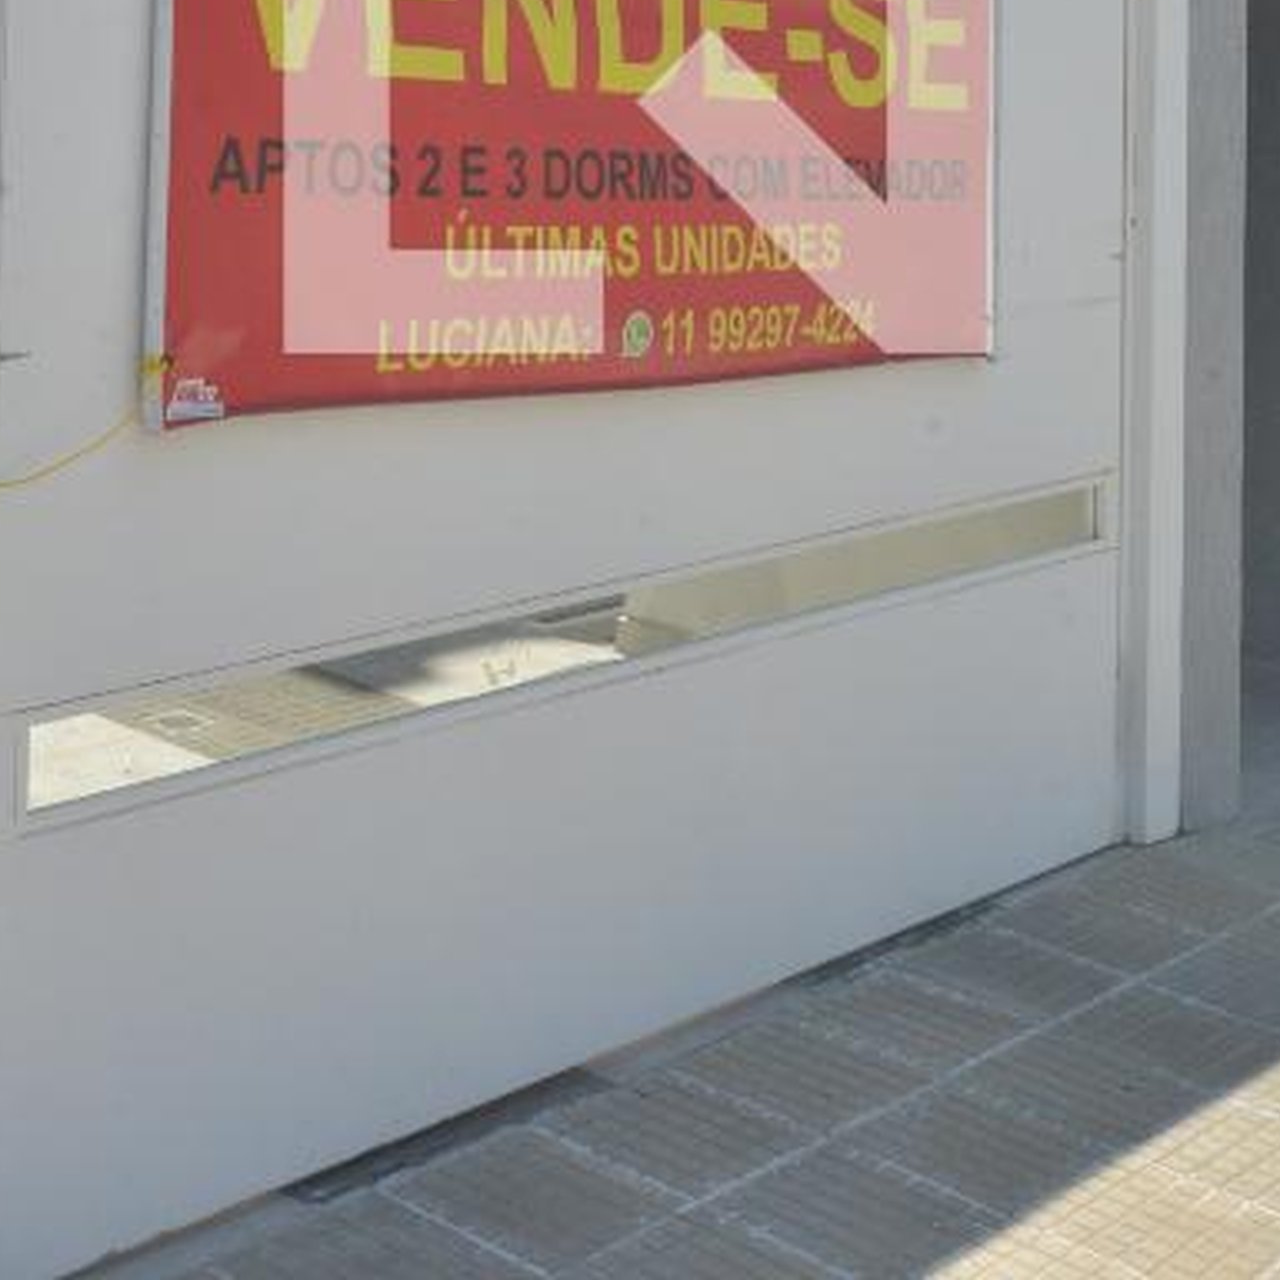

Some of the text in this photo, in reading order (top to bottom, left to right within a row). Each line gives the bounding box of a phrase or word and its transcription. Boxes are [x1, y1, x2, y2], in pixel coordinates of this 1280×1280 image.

[210, 135, 968, 203] APTOS 2 E 3 DORMS COM ELEVADOR
[443, 210, 844, 280] ÚLTIMAS UNIDADES
[376, 316, 592, 374] LUCIANA:
[661, 308, 695, 358] 11
